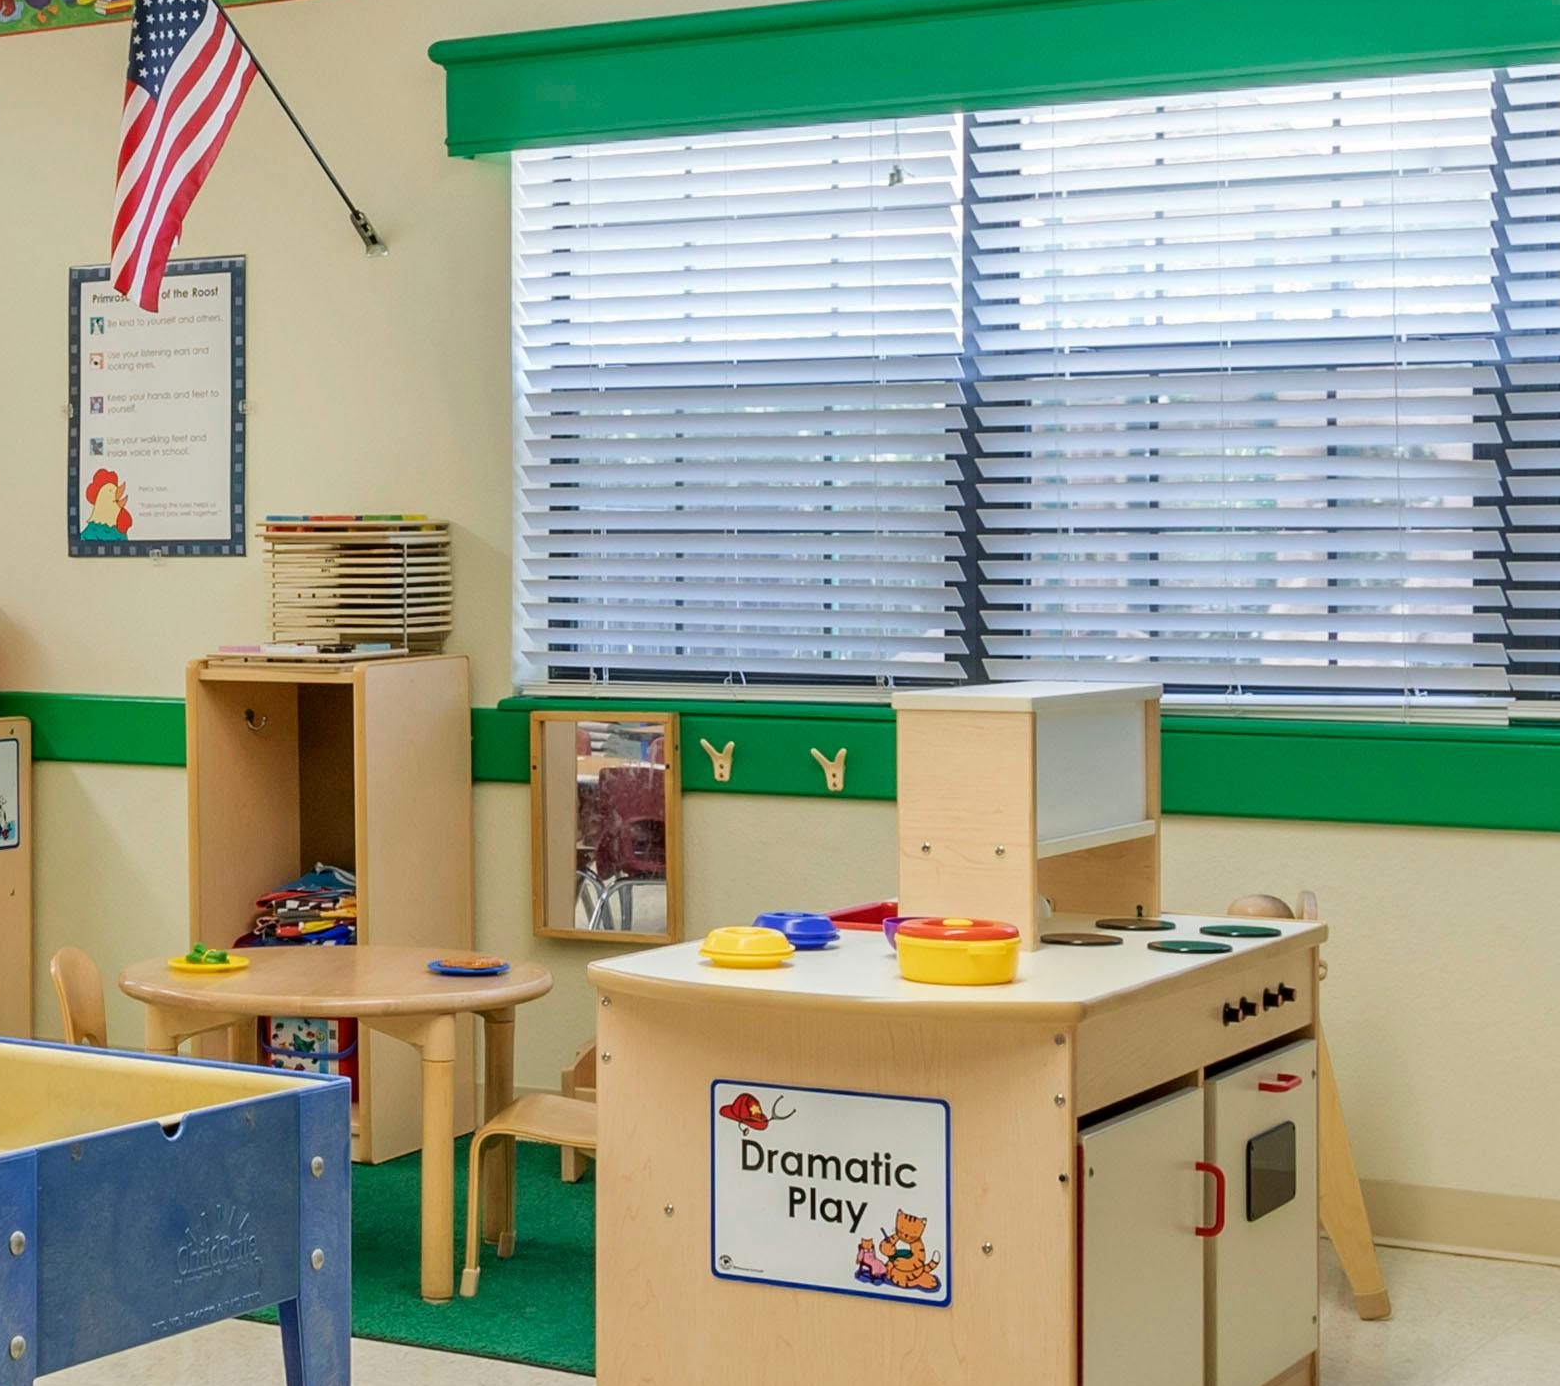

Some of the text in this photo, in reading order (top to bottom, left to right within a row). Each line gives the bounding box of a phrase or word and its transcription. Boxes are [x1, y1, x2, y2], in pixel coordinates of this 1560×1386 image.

[161, 289, 171, 299] of
[173, 288, 188, 298] the
[192, 286, 218, 297] Roost
[147, 315, 176, 327] yourself
[178, 314, 194, 323] and
[122, 350, 138, 360] your
[140, 347, 171, 359] listening
[192, 346, 209, 355] and
[129, 394, 145, 402] your
[147, 391, 172, 400] hands
[174, 390, 190, 399] and
[192, 389, 208, 398] feet
[210, 389, 219, 397] to
[122, 436, 138, 445] your
[140, 434, 170, 445] walking
[172, 434, 187, 442] feet
[190, 434, 207, 442] and
[130, 448, 151, 457] voice
[741, 1139, 917, 1189] Dramatic
[789, 1185, 868, 1233] Play
